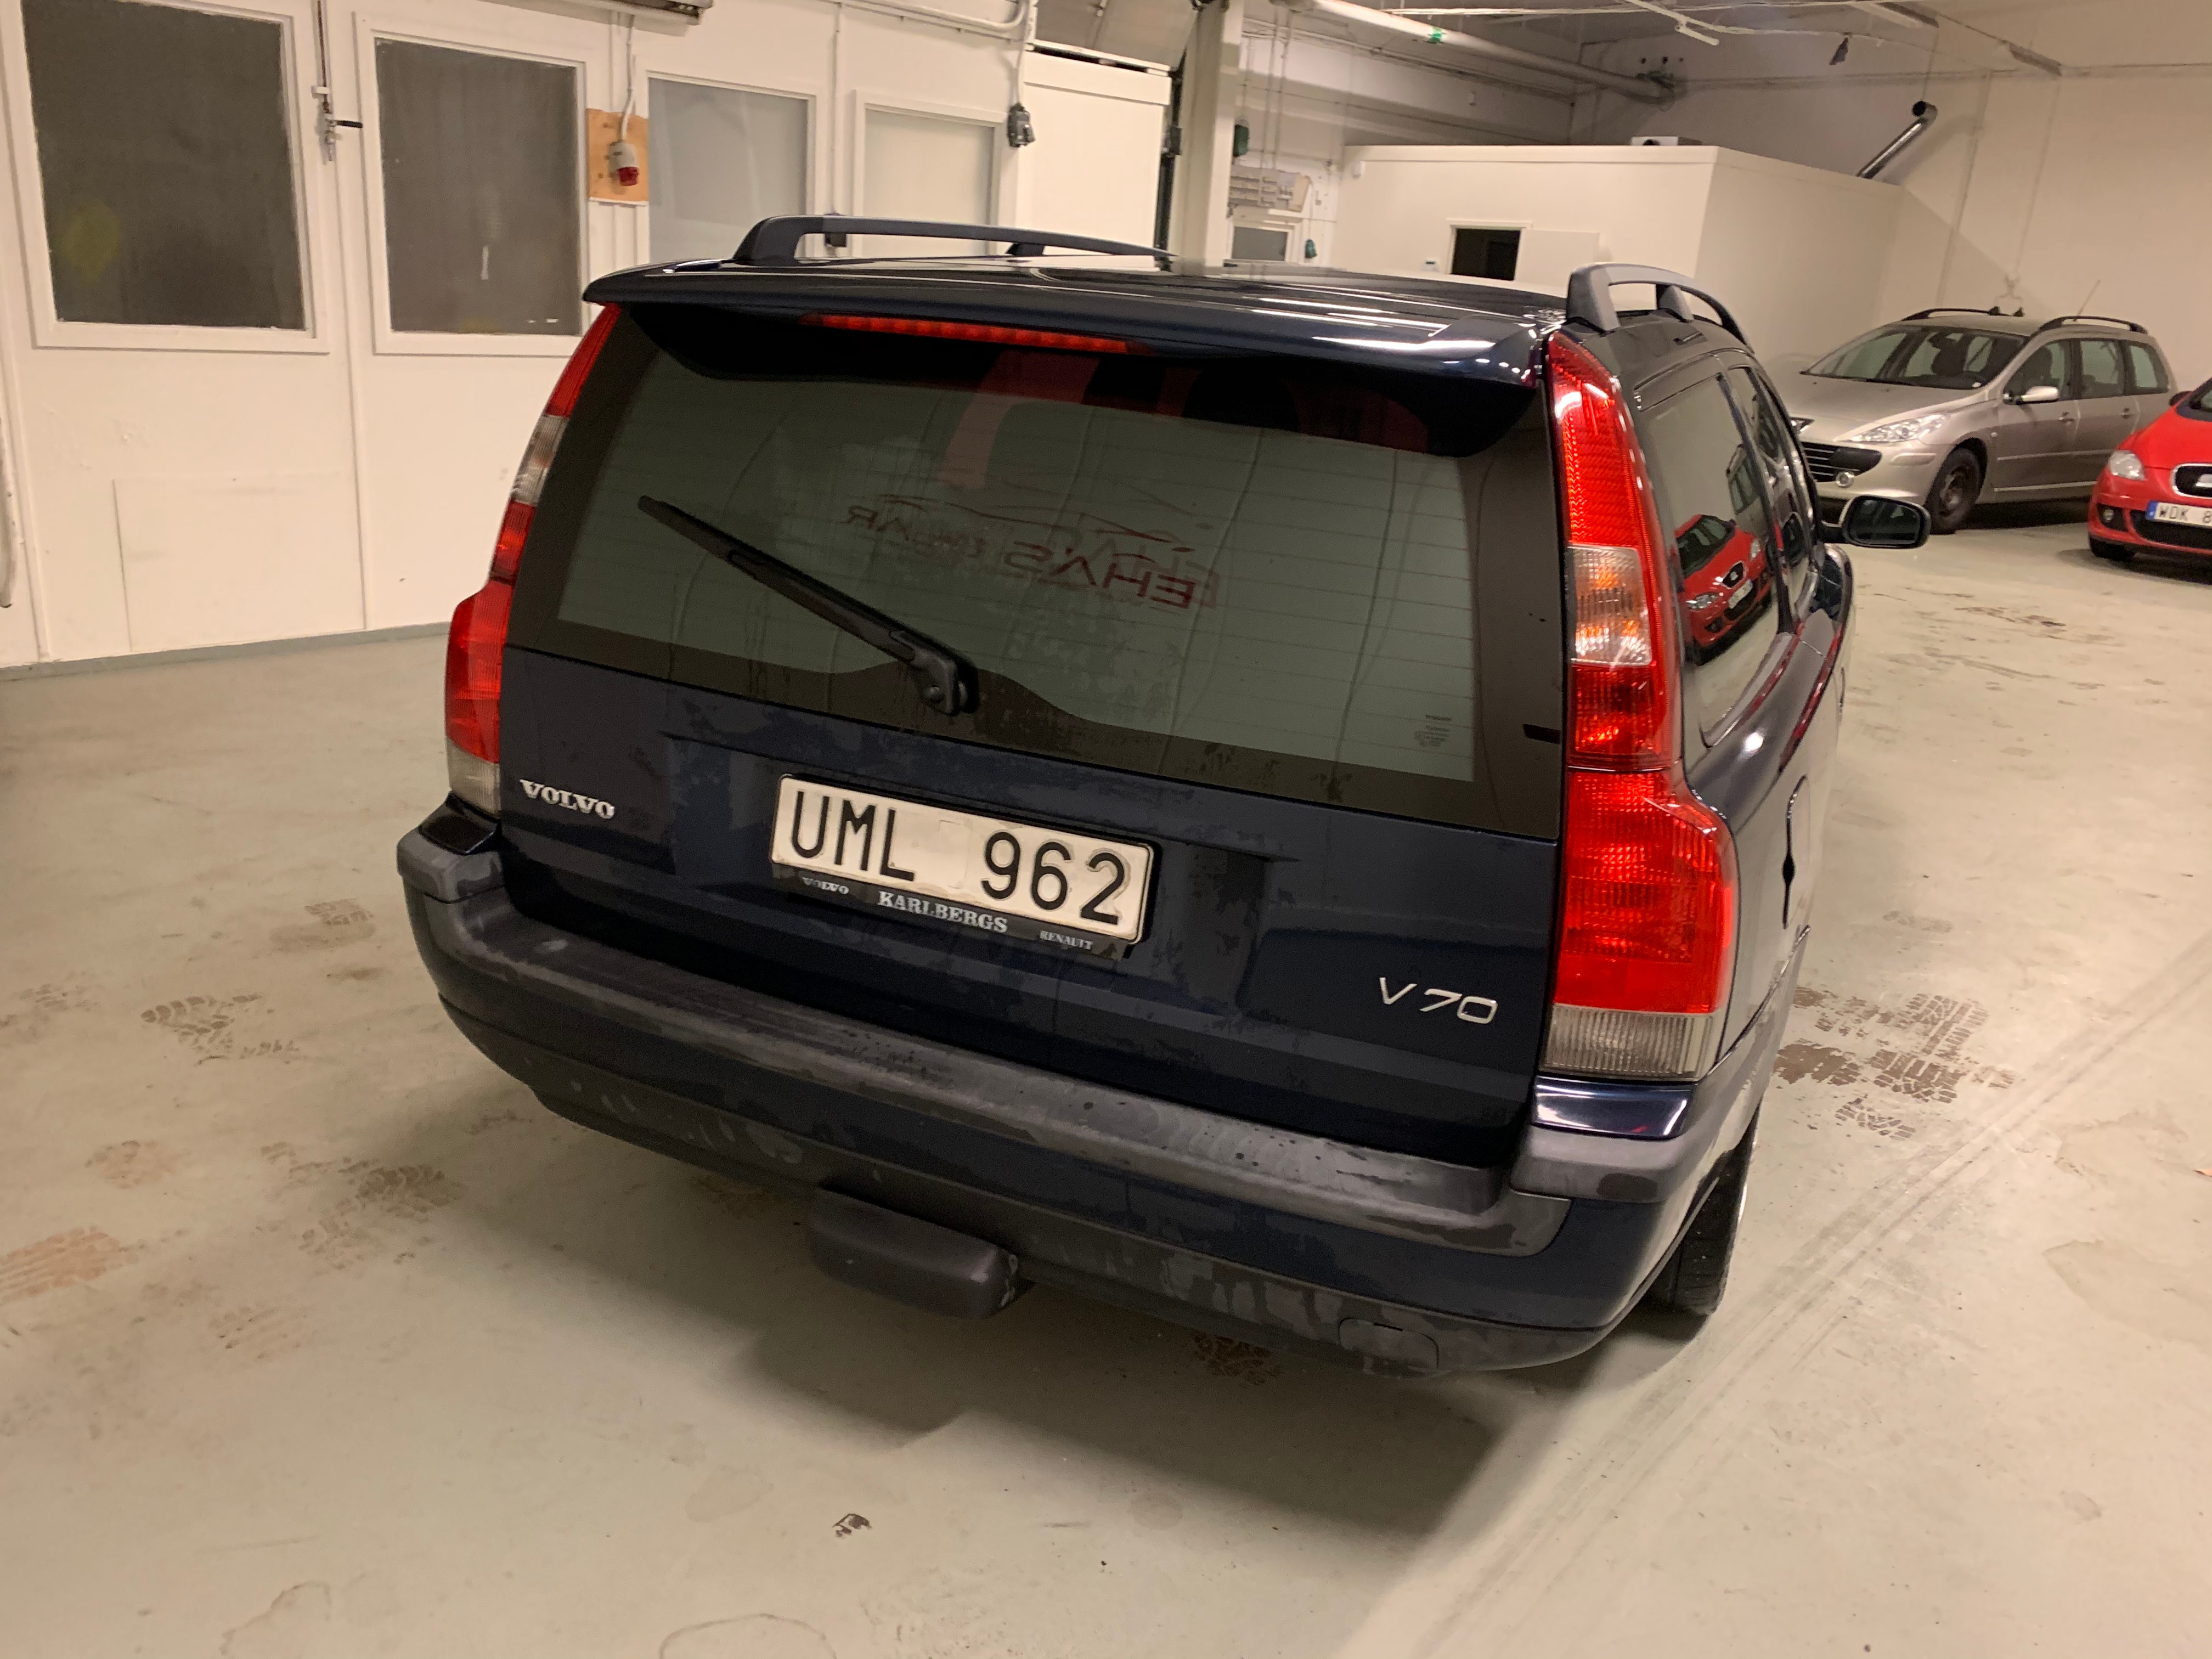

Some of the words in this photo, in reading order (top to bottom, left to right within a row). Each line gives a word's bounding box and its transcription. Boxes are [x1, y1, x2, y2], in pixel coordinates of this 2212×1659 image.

[520, 779, 615, 819] VOLVO
[791, 791, 915, 882] UML
[981, 831, 1125, 926] 962
[878, 890, 1008, 933] KARLBERGS
[1040, 930, 1093, 950] RENAULT
